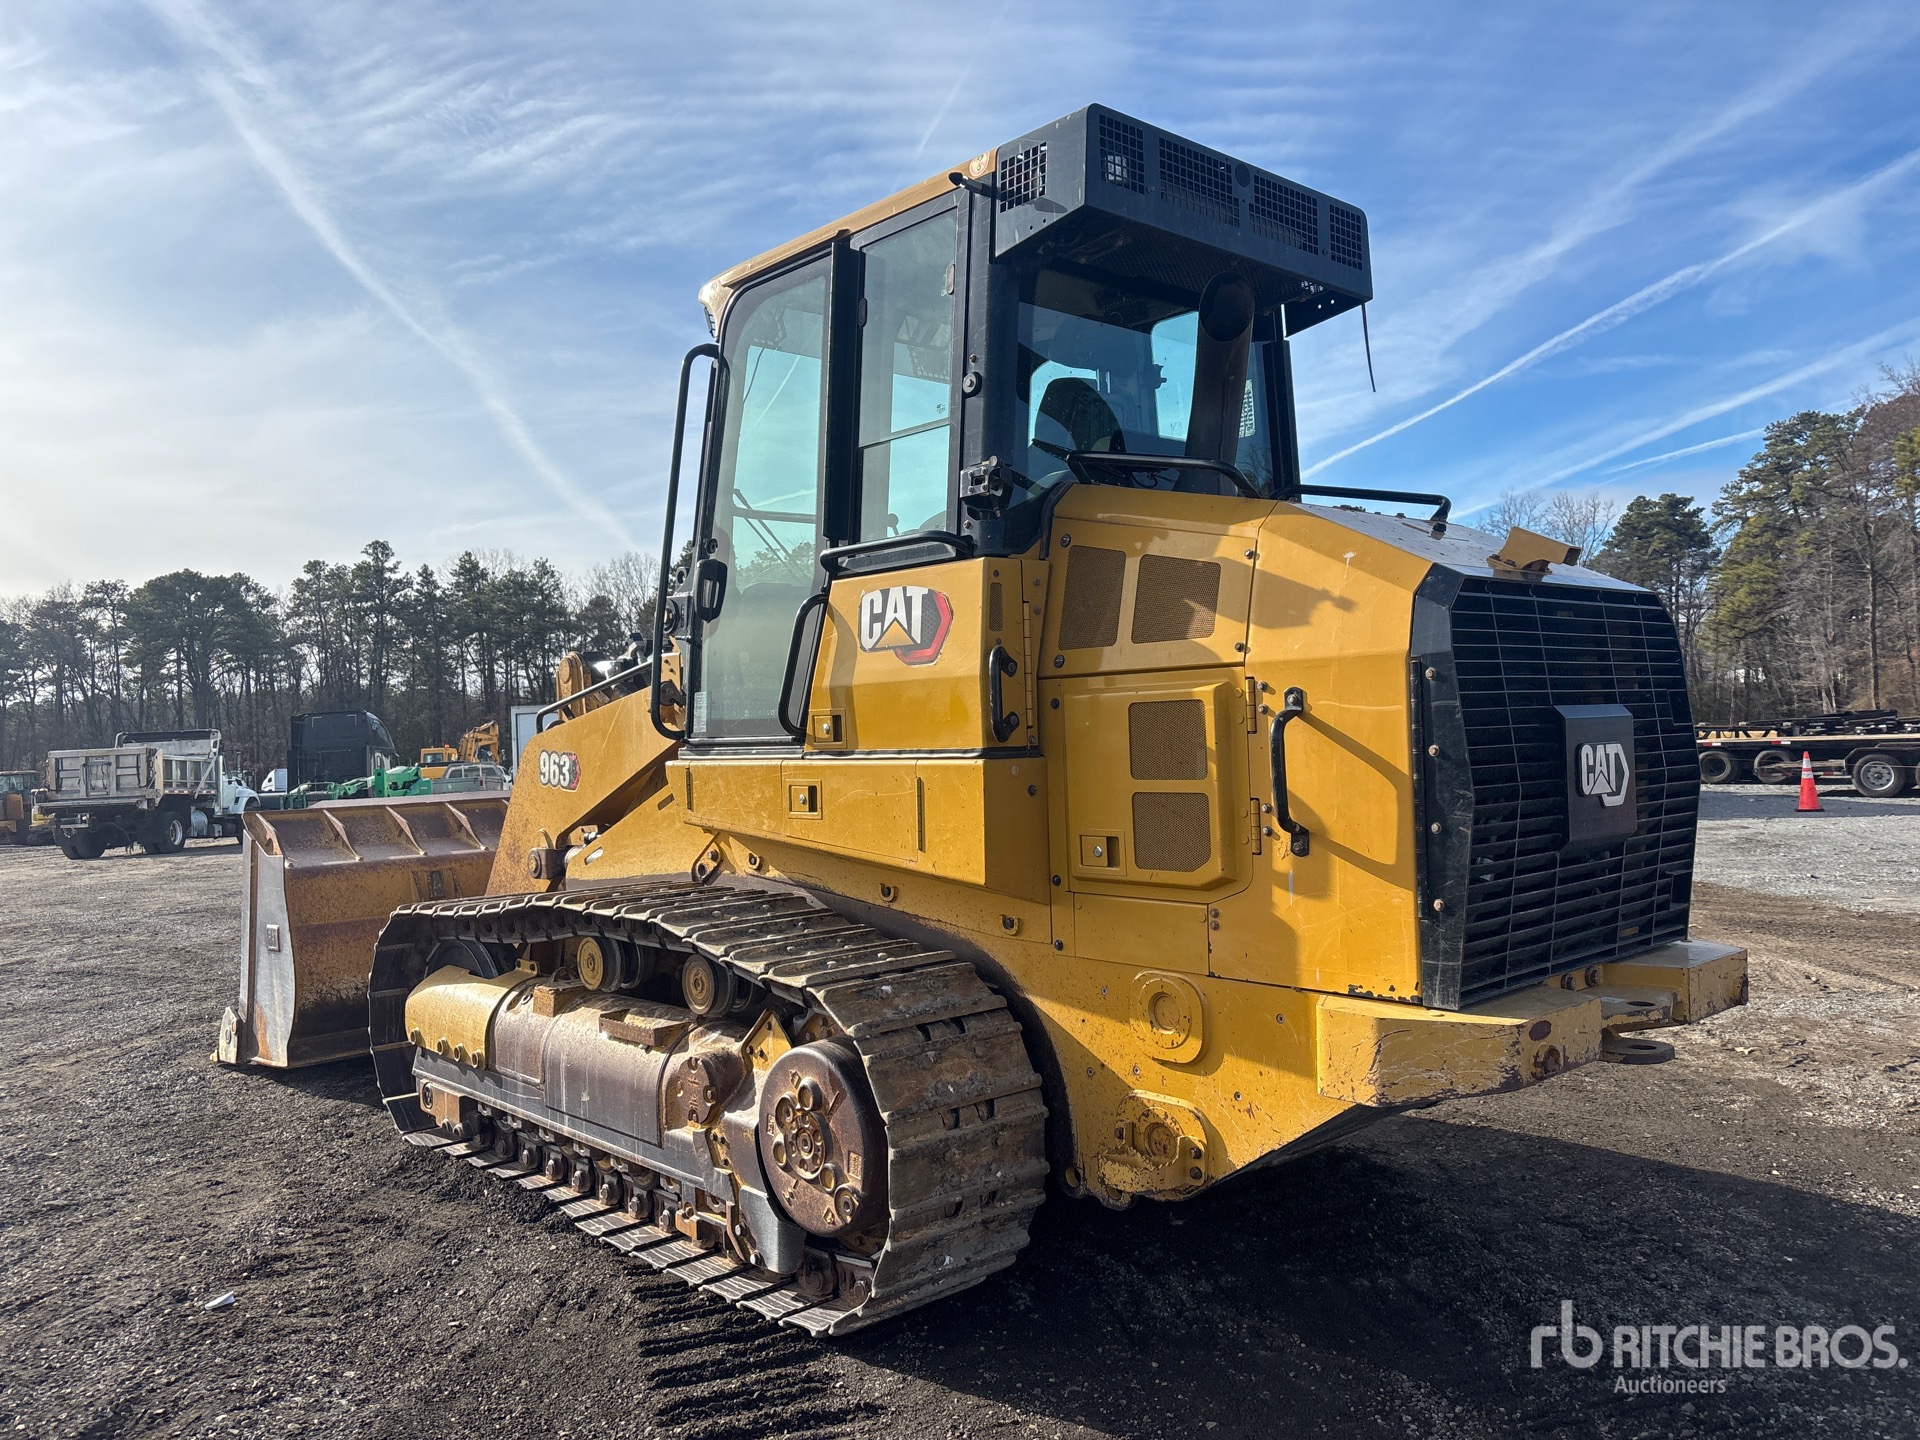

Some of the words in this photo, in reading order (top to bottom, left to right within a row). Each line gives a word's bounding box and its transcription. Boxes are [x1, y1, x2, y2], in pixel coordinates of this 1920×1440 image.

[861, 586, 929, 650] CAT
[540, 751, 570, 787] 963
[1581, 743, 1619, 795] CAT
